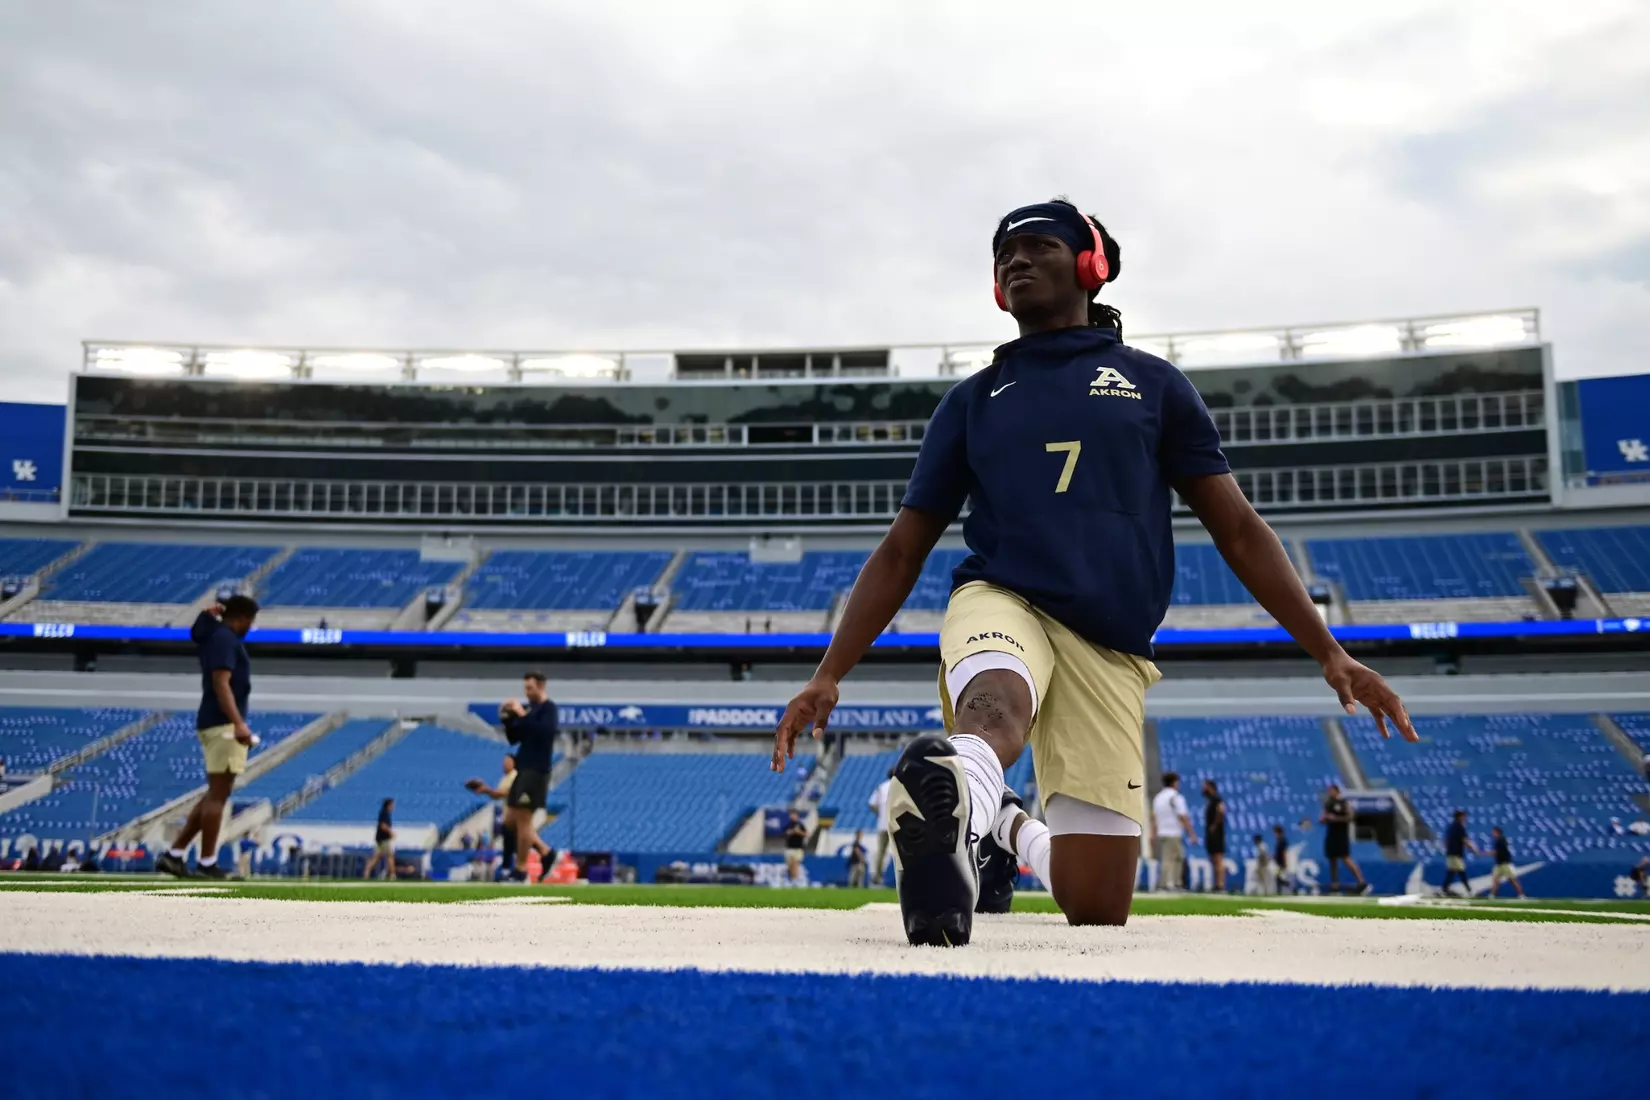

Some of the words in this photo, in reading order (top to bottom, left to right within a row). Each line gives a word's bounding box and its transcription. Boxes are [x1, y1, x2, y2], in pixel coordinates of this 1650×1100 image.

[1090, 366, 1136, 389] A
[1089, 388, 1142, 400] AKRON
[1045, 440, 1082, 493] 7
[965, 631, 1025, 652] AKRON
[696, 708, 777, 725] PADDOCK
